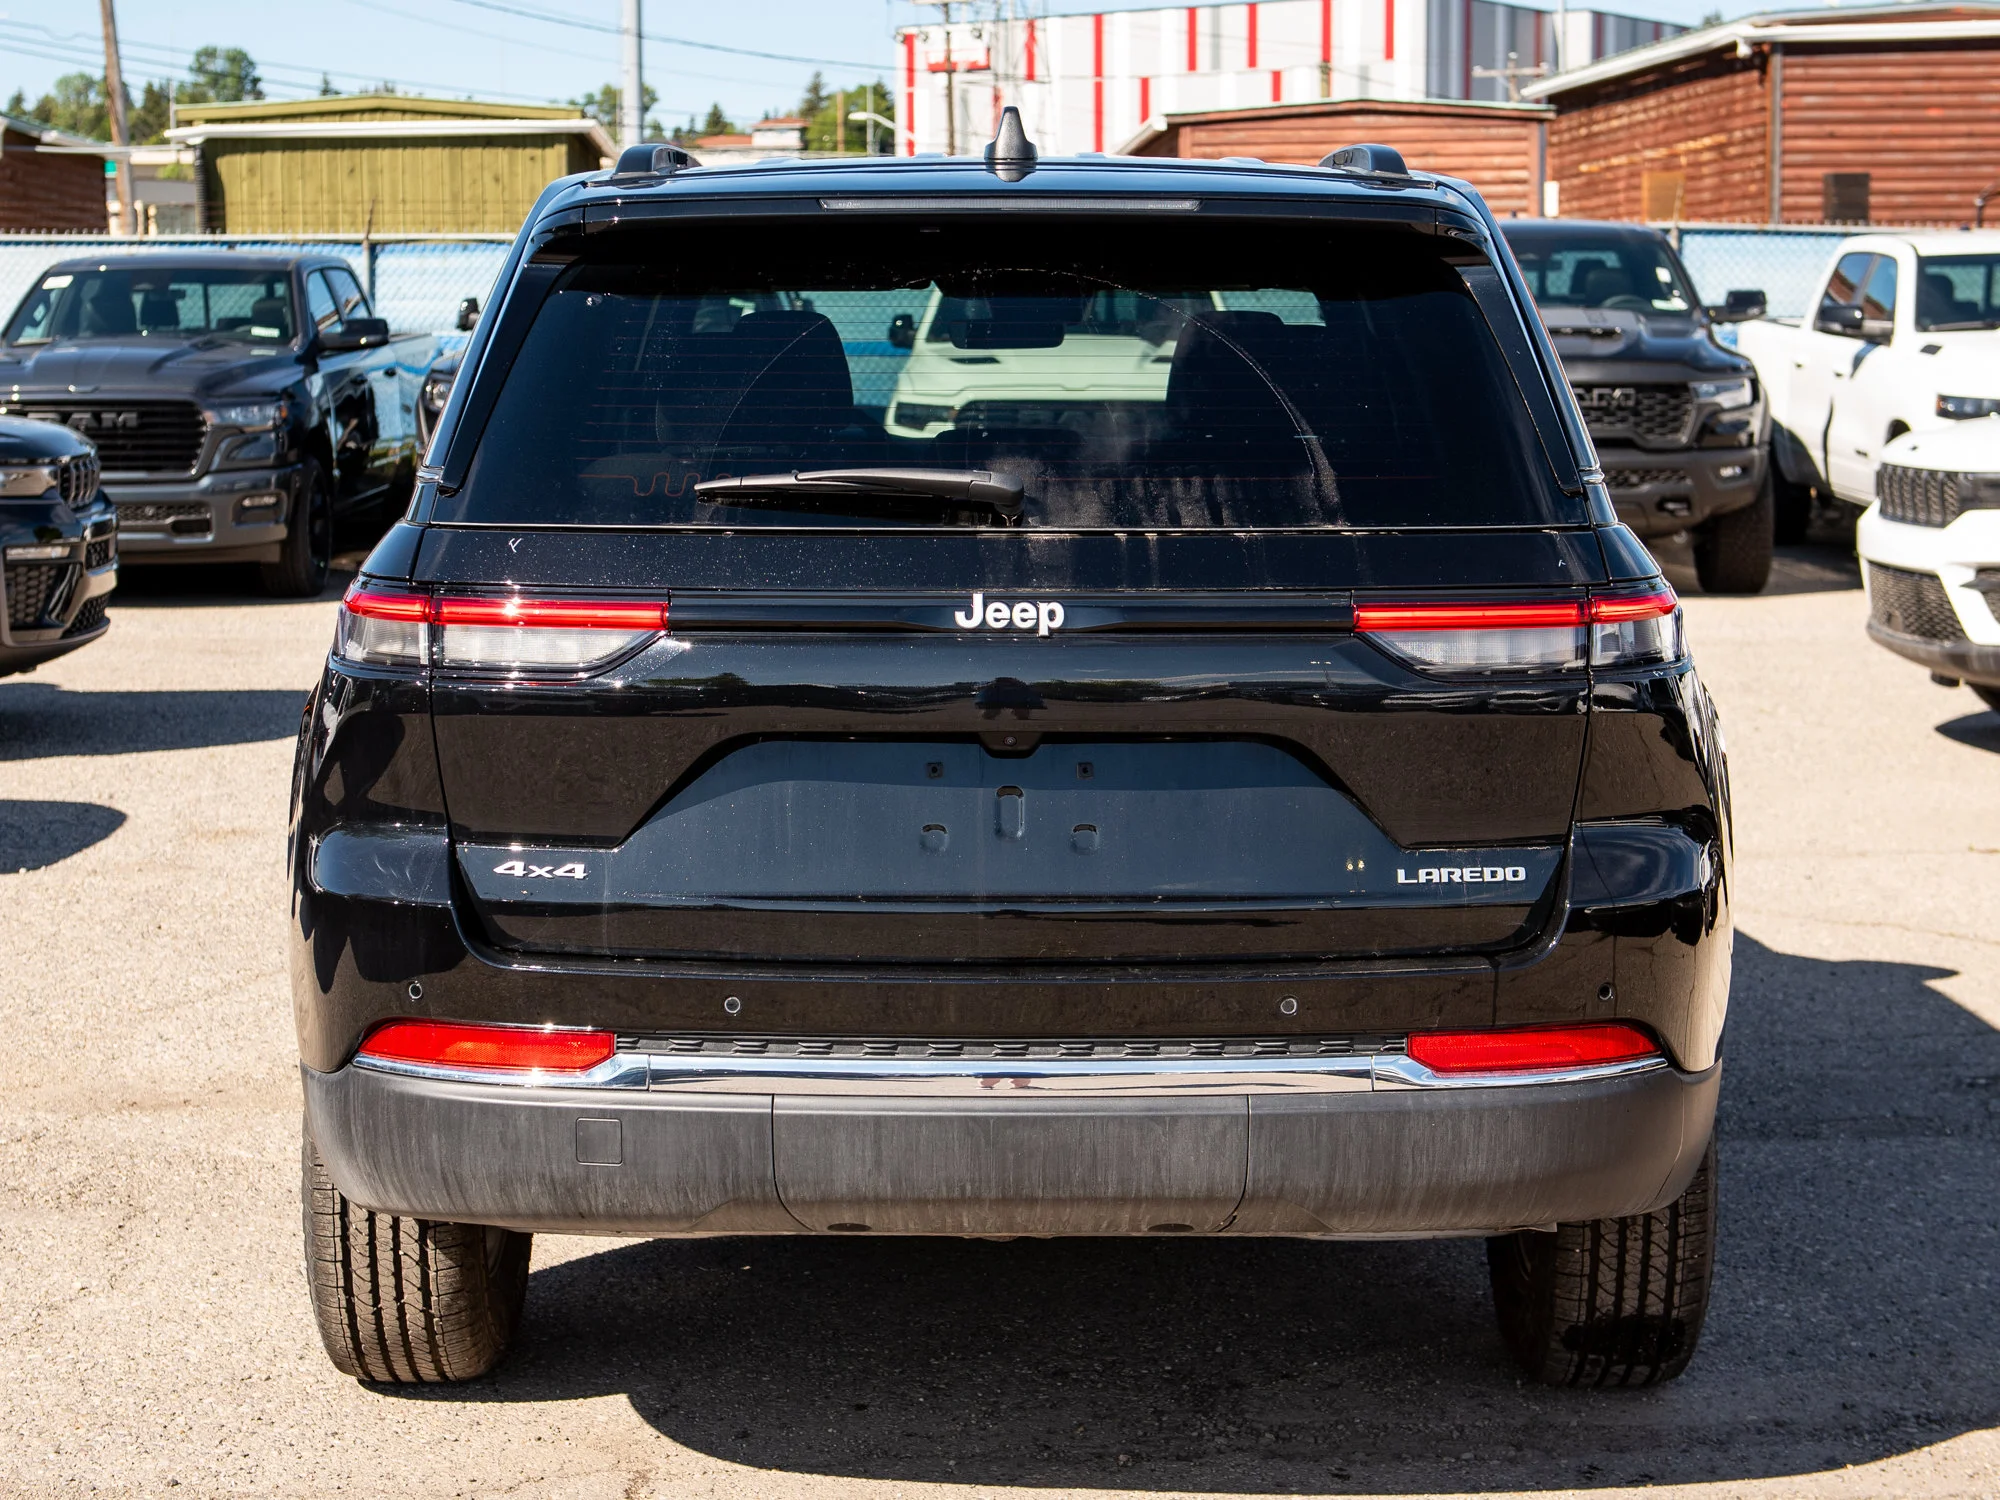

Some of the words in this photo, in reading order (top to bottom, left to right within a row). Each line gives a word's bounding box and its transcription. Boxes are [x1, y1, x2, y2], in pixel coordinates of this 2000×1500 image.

[954, 592, 1065, 636] Jeep
[492, 860, 589, 880] 4x4
[1397, 866, 1527, 884] LAREDO
